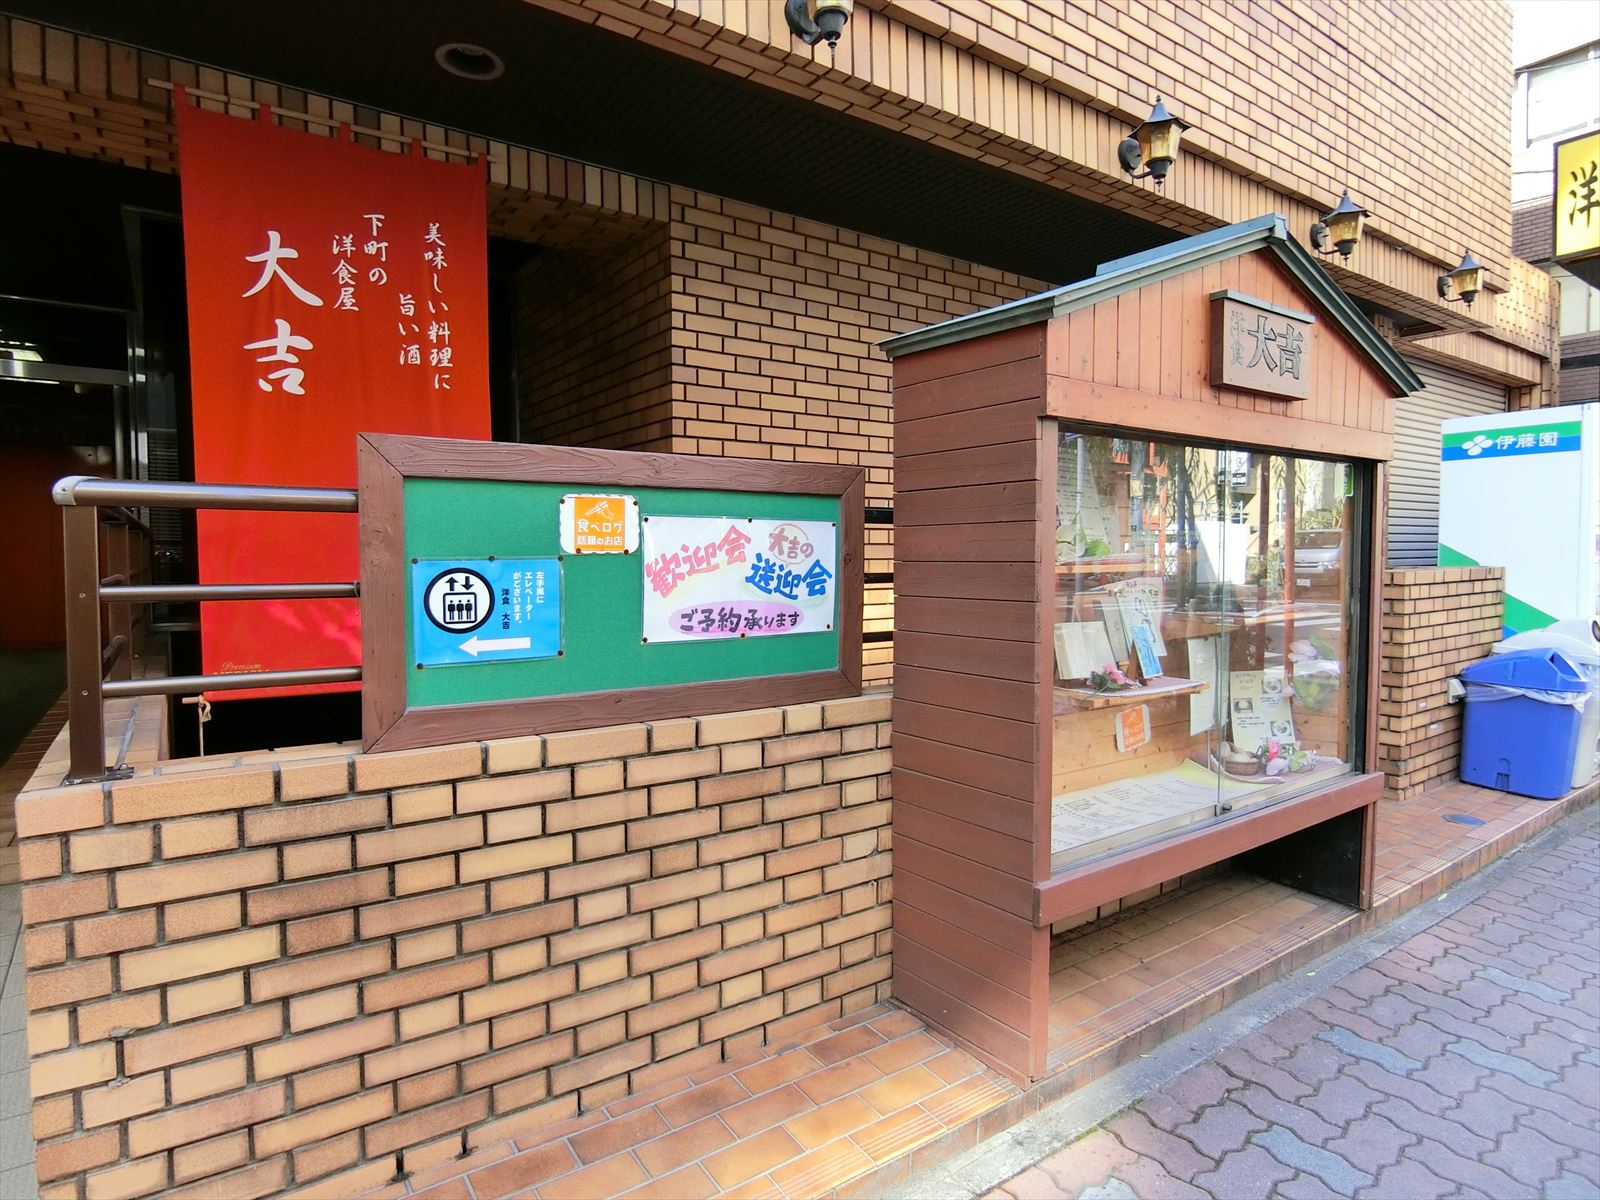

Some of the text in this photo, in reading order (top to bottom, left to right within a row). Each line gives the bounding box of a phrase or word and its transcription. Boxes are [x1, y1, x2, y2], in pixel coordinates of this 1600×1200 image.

[1568, 160, 1600, 228] 洋
[331, 233, 360, 312] 洋食屋
[363, 213, 389, 287] 下町の
[242, 230, 324, 396] 大吉
[397, 293, 421, 366] 旨い酒
[423, 222, 454, 391] 美味しい料理に
[1247, 314, 1304, 380] 大吉
[1494, 431, 1559, 450] 伊藤園
[576, 518, 624, 534] 食べログ
[768, 527, 814, 559] 大吉の
[645, 524, 752, 599] 歓迎会
[745, 552, 833, 600] 送迎会
[501, 613, 510, 630] 大吉
[524, 571, 534, 620] エレベーター
[680, 607, 800, 633] ご予約承ります
[222, 662, 262, 670] Premium
